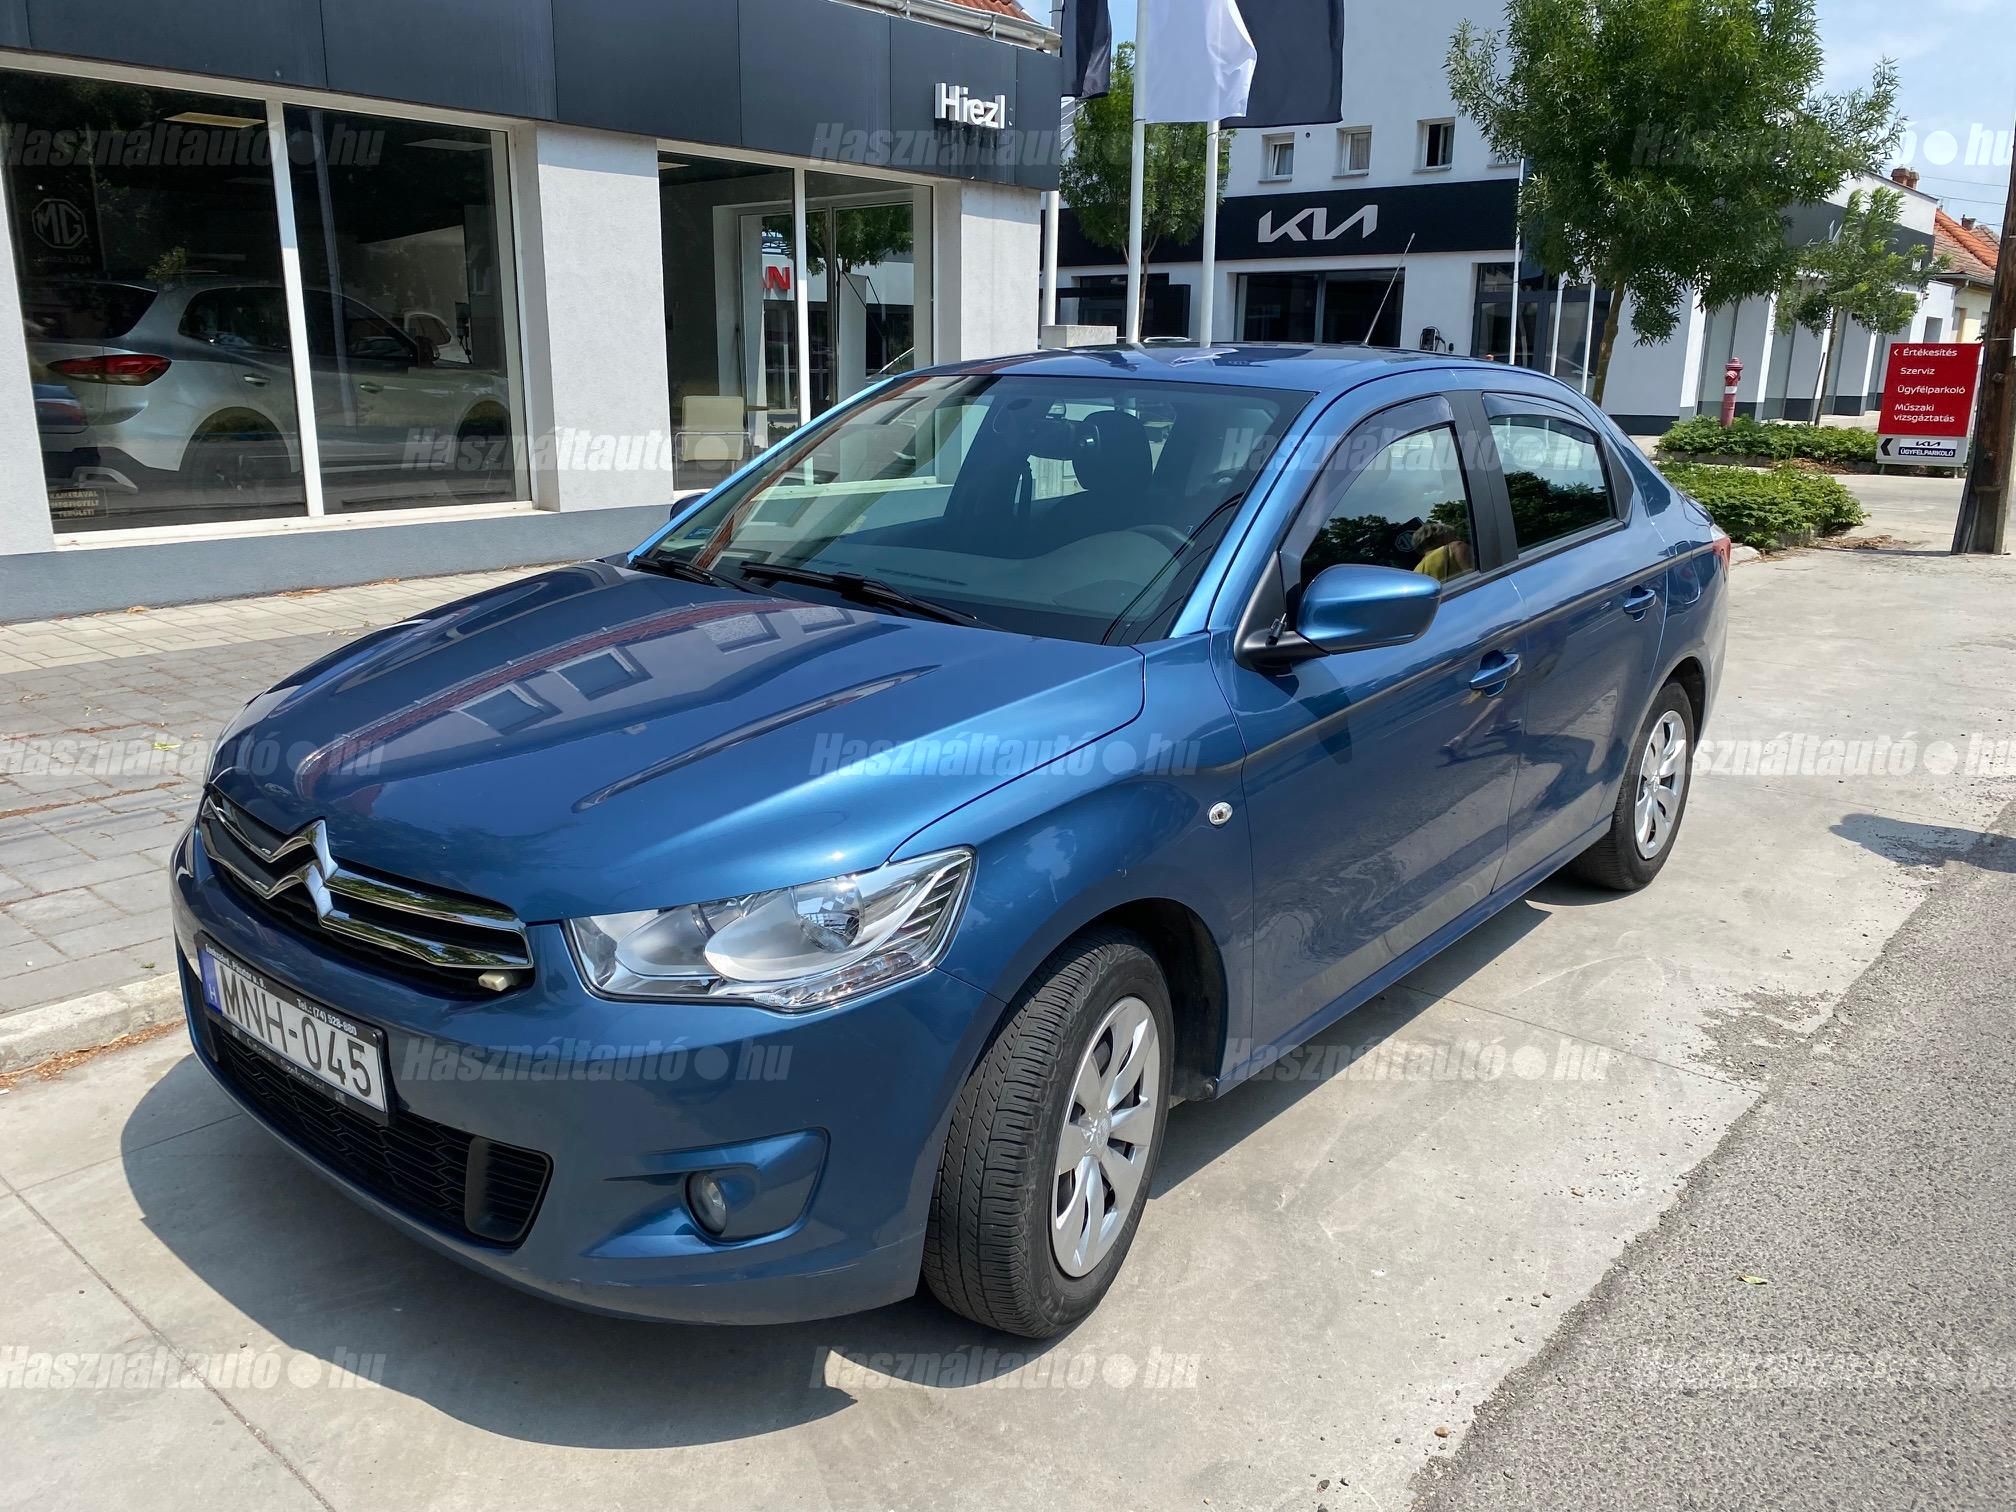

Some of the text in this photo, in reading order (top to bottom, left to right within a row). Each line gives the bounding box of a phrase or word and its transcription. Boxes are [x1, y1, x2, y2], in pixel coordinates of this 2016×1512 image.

[935, 82, 1005, 129] Hiezl
[36, 203, 83, 246] MG
[1258, 204, 1378, 242] KIA
[1902, 347, 1958, 357] Értékesítés
[1900, 367, 1936, 375] Szerviz
[1897, 384, 1966, 395] Ügyfélparkoló
[1894, 403, 1935, 412] Műszaki
[1893, 413, 1955, 423] vizsgáztatás
[209, 984, 218, 1004] H
[220, 964, 372, 1098] MNH-045
